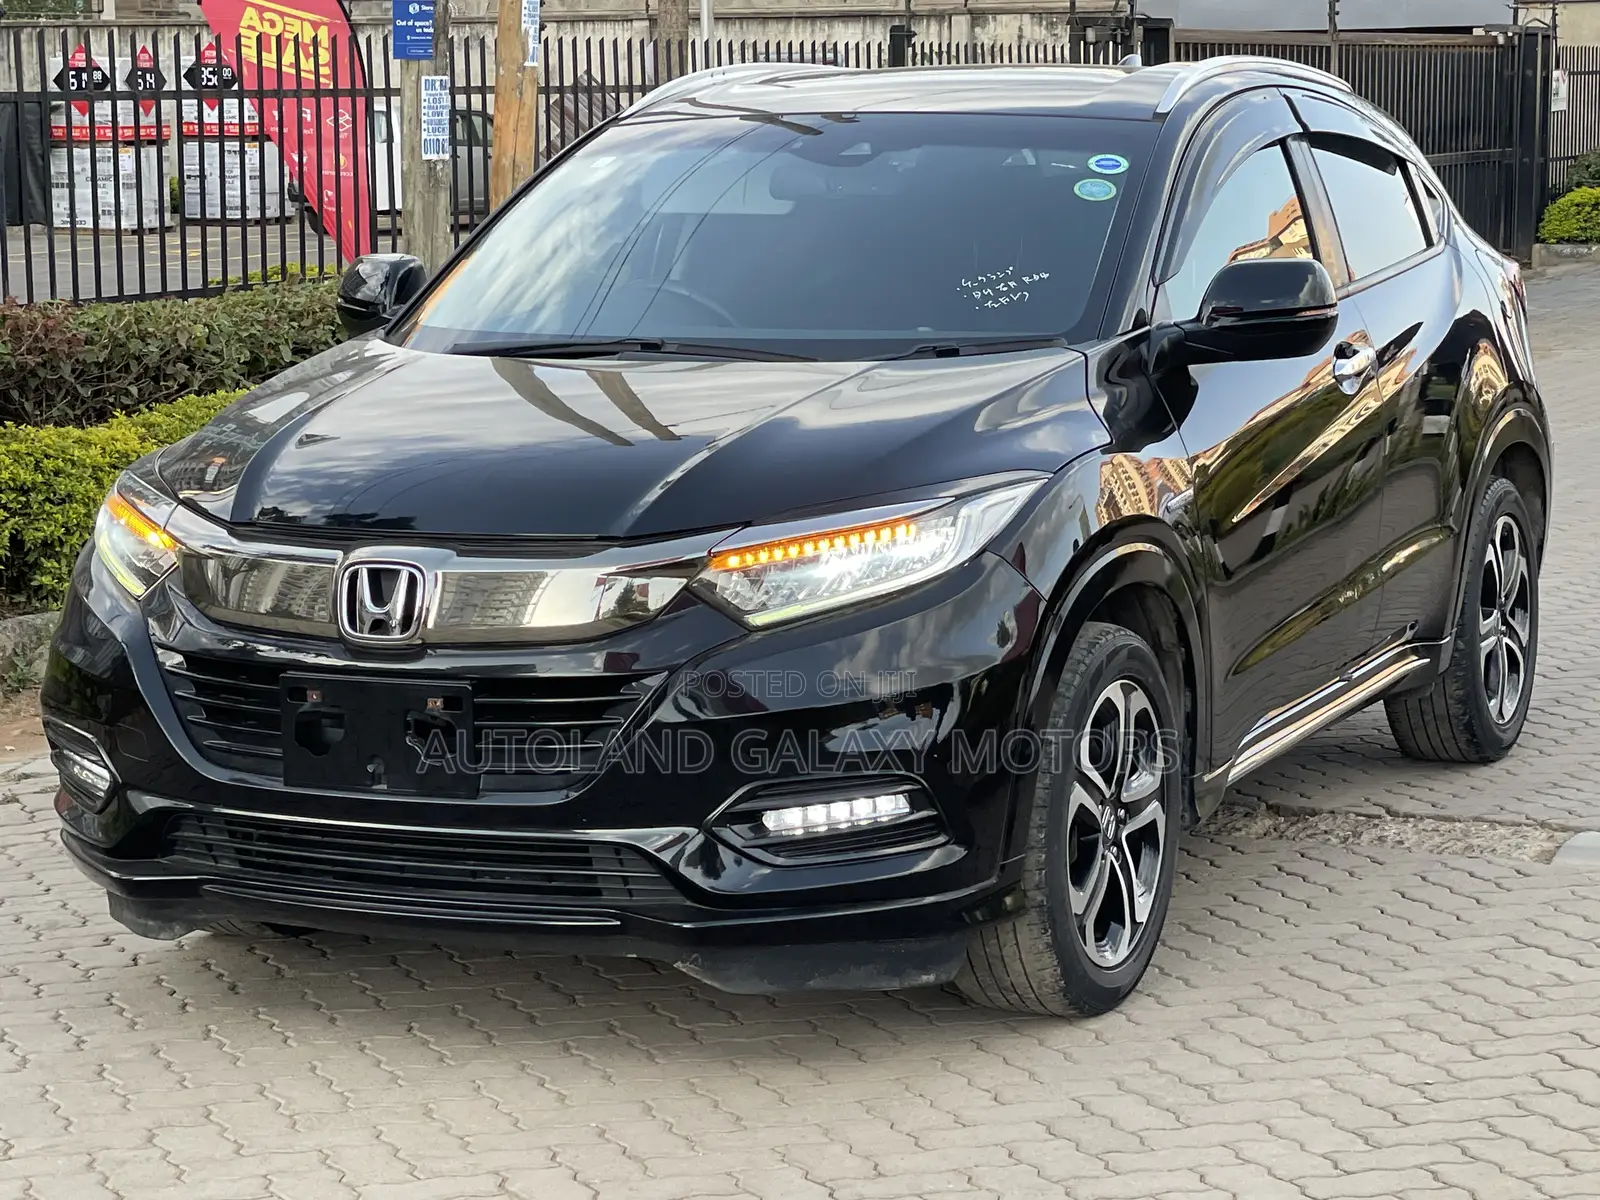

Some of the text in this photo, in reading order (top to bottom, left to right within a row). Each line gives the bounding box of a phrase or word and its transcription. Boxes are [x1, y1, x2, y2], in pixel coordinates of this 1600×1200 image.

[407, 18, 414, 26] of
[414, 19, 433, 28] space?
[427, 110, 444, 118] LOVE
